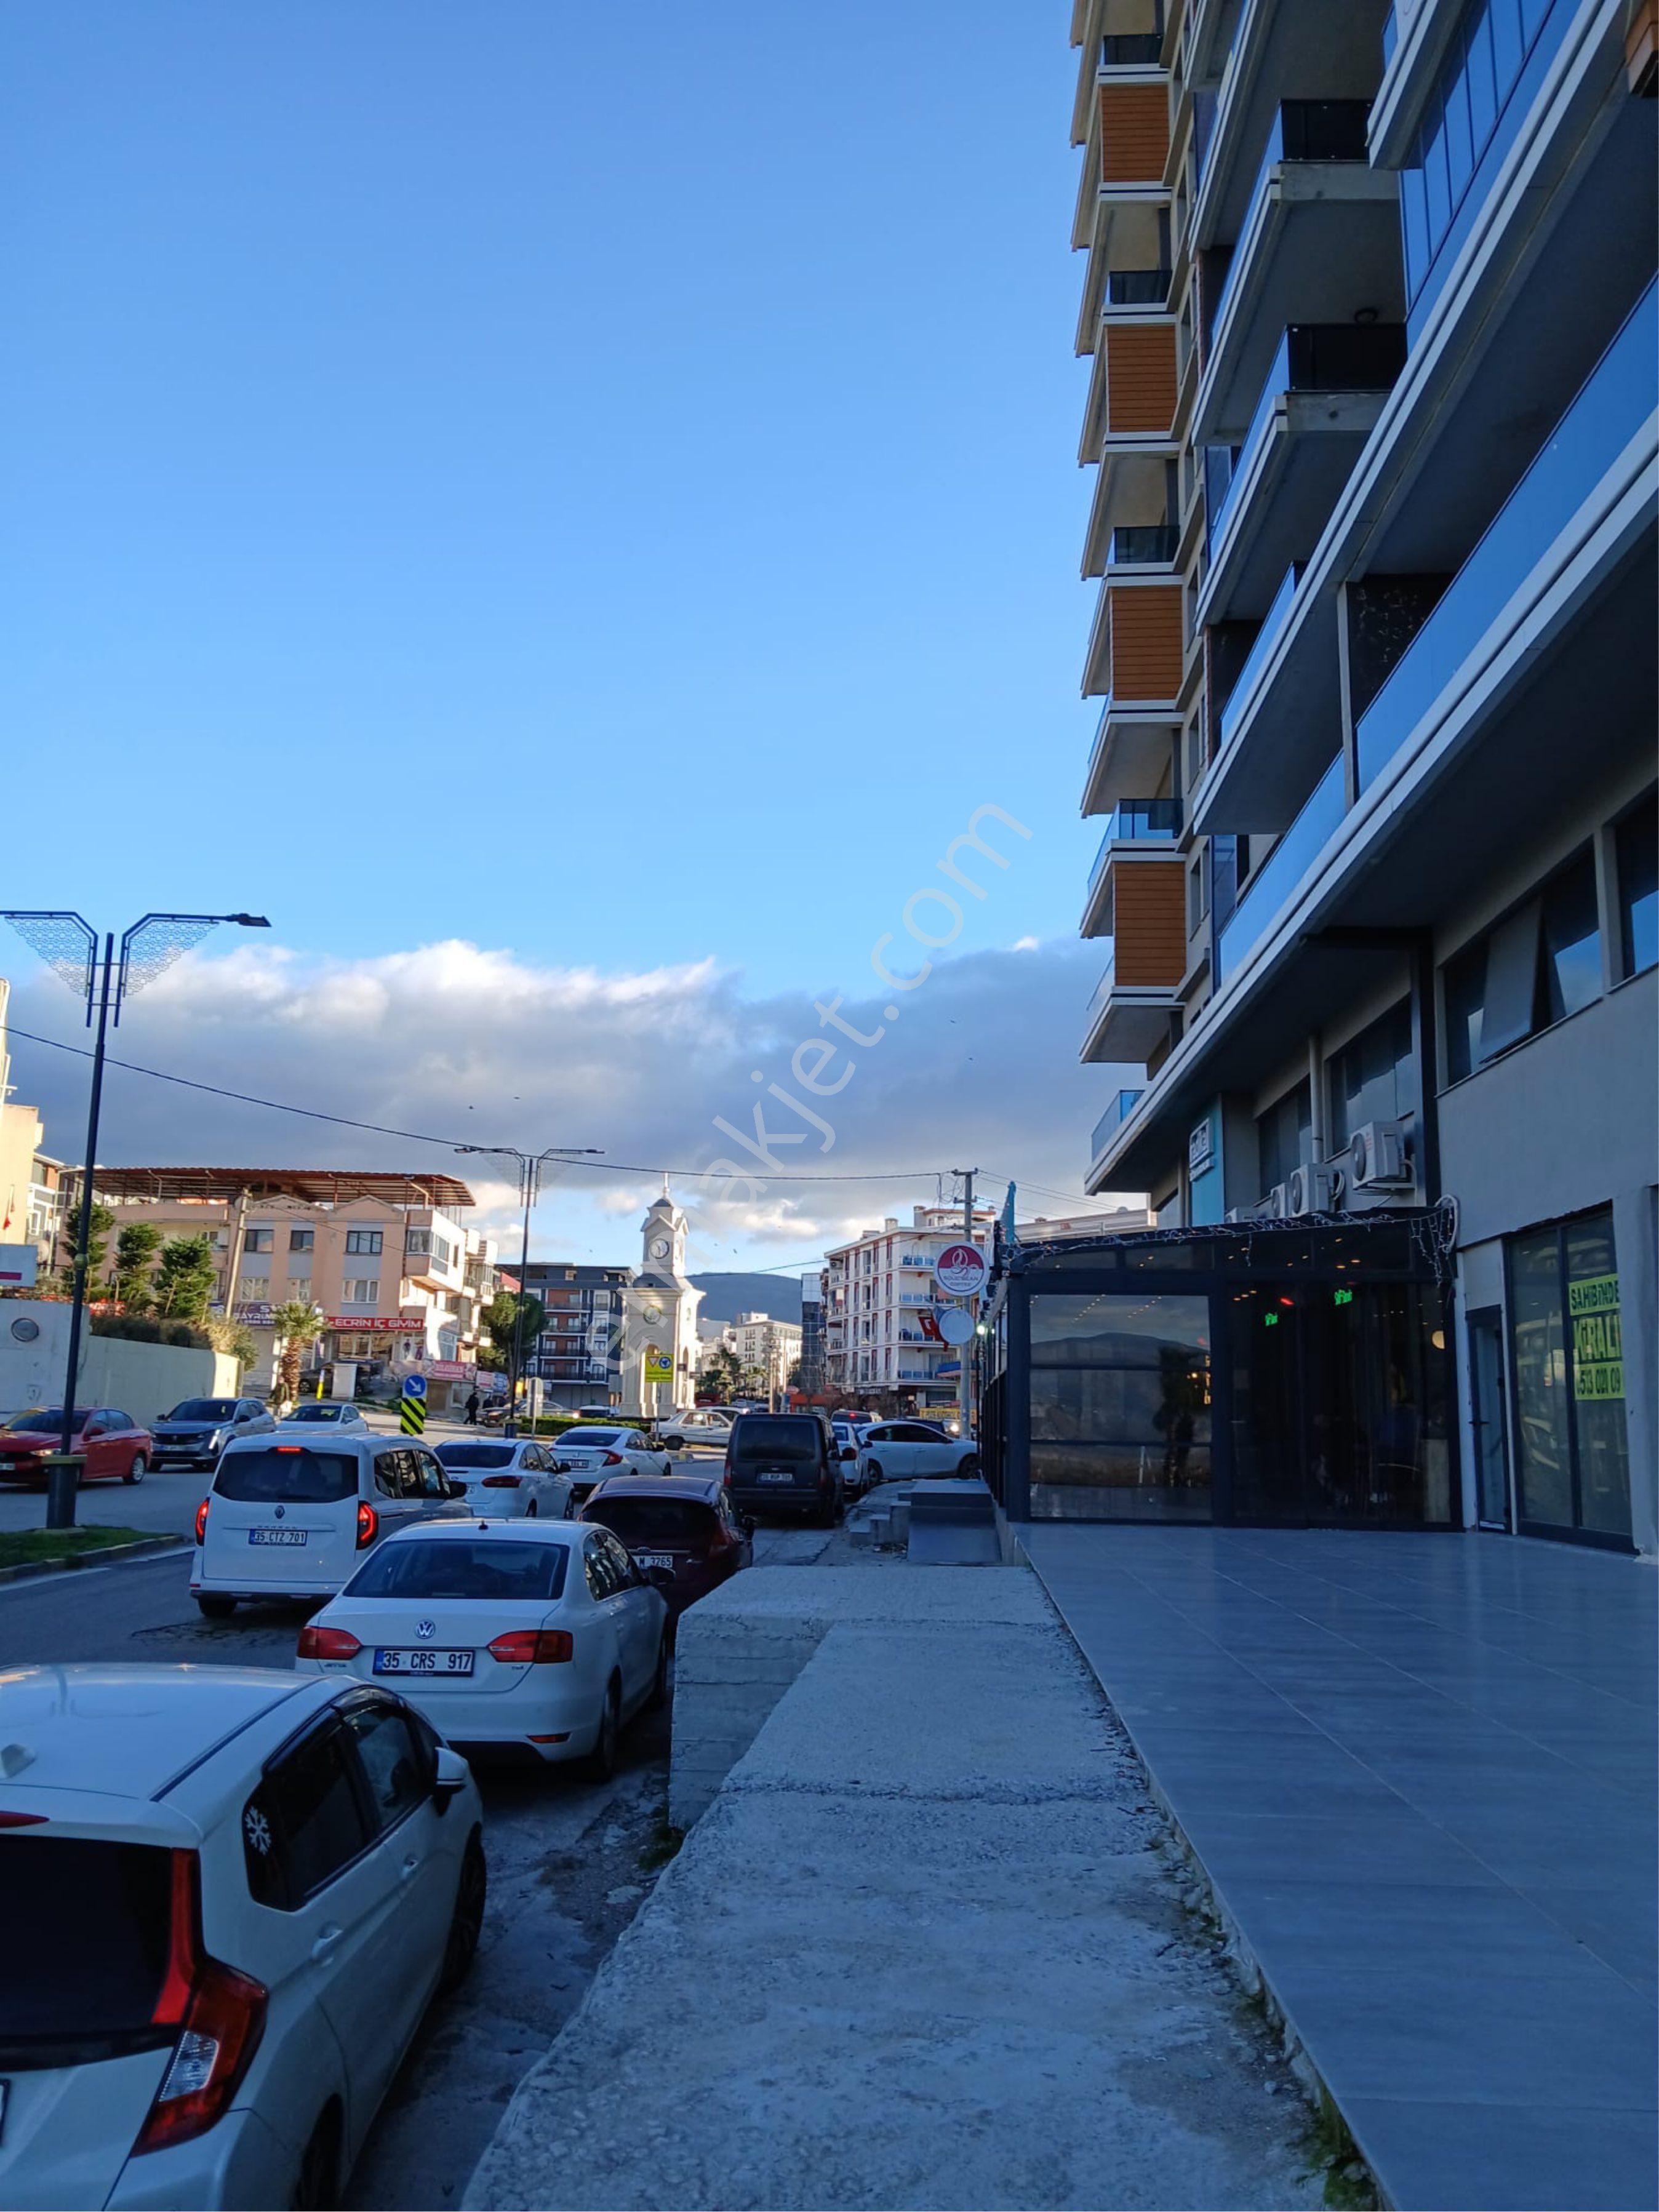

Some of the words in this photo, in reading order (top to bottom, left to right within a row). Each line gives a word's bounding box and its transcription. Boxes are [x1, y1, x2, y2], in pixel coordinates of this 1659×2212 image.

[335, 1318, 371, 1327] ECRİN
[374, 1318, 385, 1328] İÇ
[388, 1319, 420, 1328] GİYİM
[255, 1532, 265, 1541] 35
[269, 1532, 285, 1542] CTZ
[289, 1532, 305, 1542] 701
[383, 1652, 400, 1668] 35
[410, 1653, 435, 1669] CRS
[448, 1653, 472, 1670] 917
